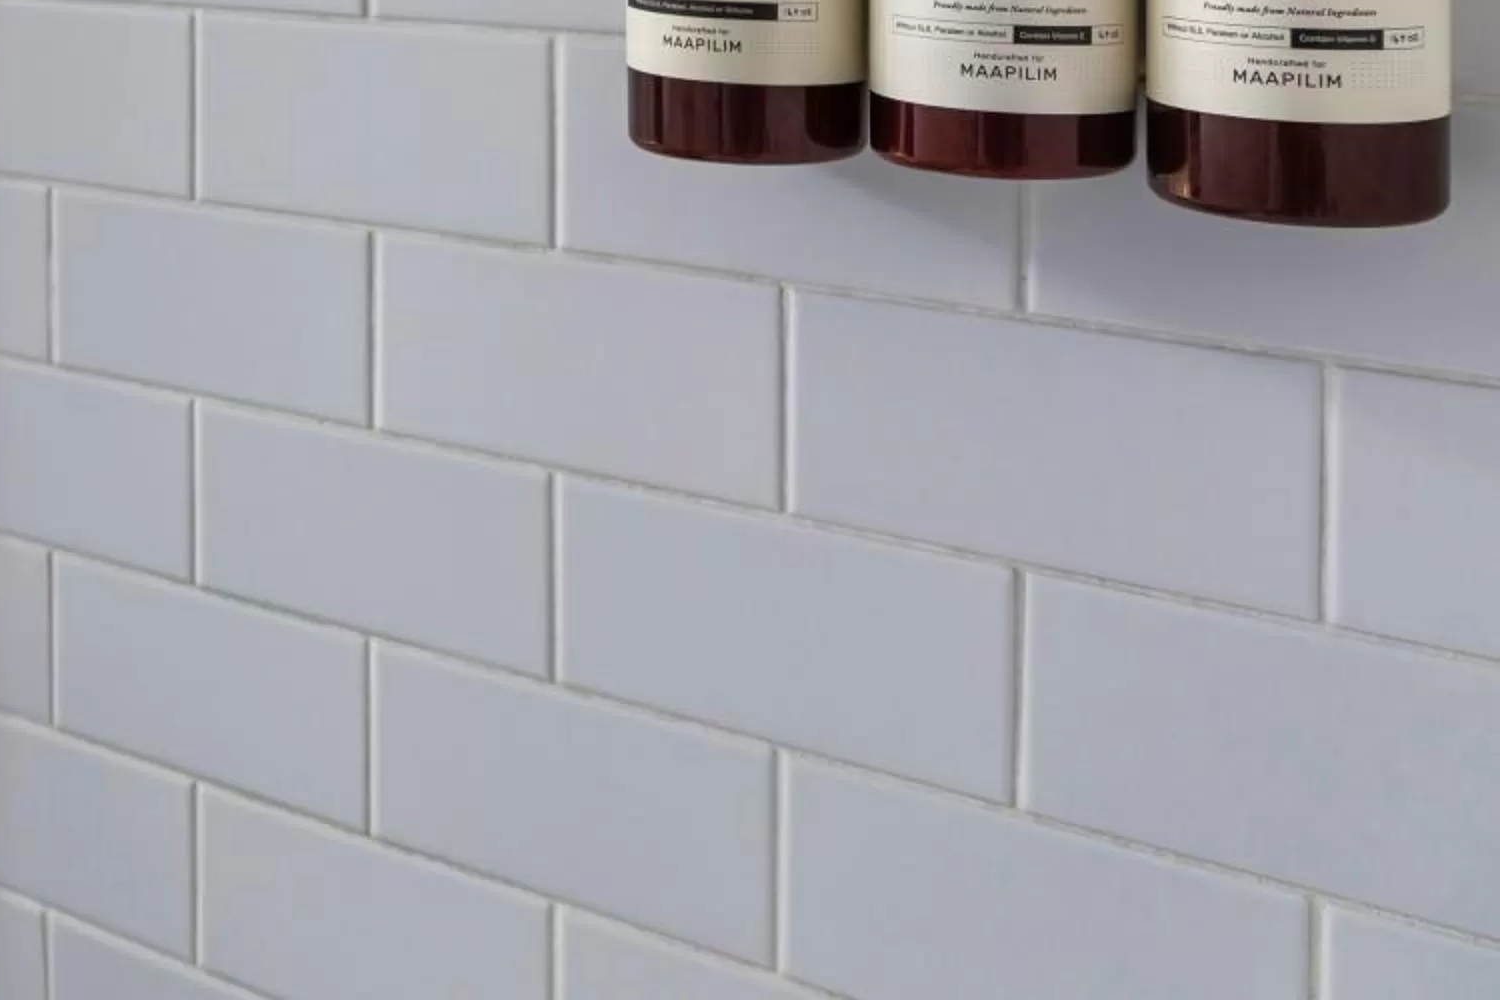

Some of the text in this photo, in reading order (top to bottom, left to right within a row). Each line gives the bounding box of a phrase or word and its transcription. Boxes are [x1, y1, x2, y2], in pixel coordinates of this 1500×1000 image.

[663, 35, 742, 53] MAAPILIM
[961, 63, 1057, 81] MAAPILIM
[1233, 68, 1342, 89] MAAPILIM
